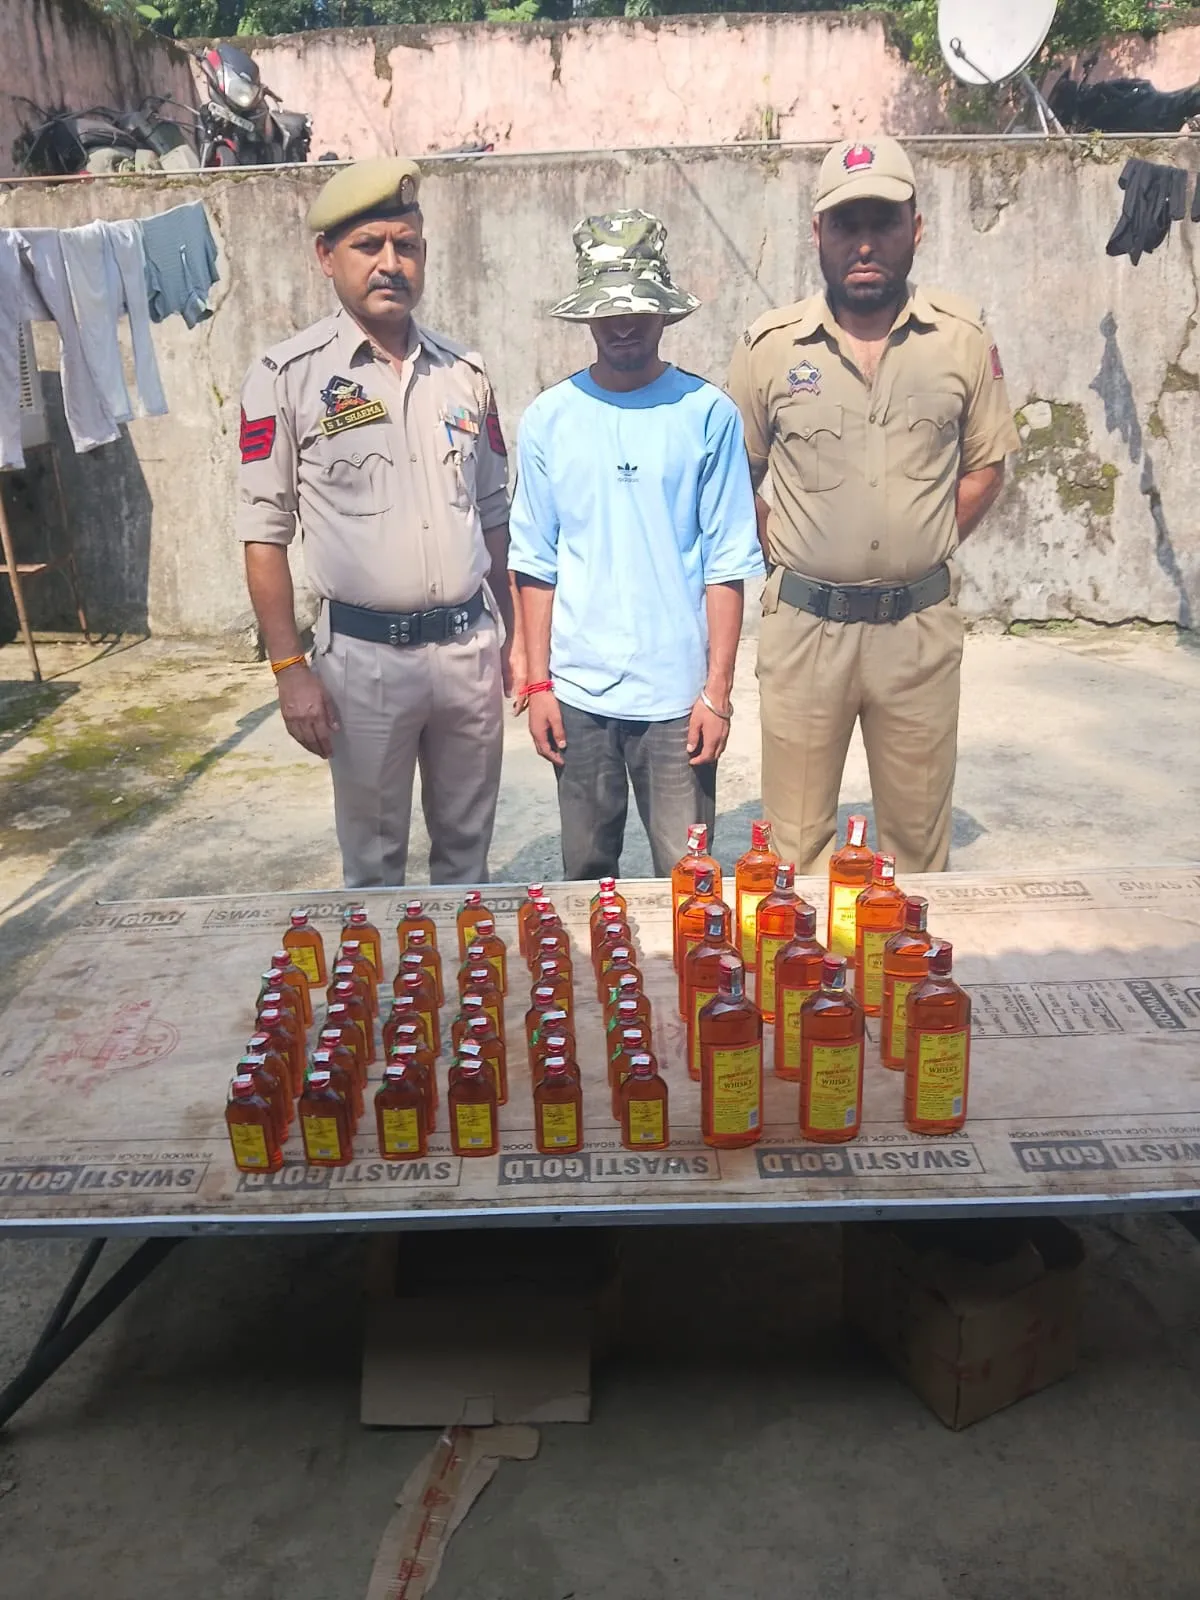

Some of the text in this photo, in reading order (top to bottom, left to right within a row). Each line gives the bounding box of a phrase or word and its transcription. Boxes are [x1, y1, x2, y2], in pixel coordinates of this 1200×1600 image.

[327, 404, 382, 430] S L SHARMA
[935, 885, 1019, 898] SWASTI
[1131, 982, 1177, 1027] PLYWOOD
[503, 1143, 534, 1151] DOOR
[1021, 1142, 1200, 1167] WASTI GOLD
[333, 1162, 451, 1183] SWASTI
[503, 1155, 709, 1179] SWASTI GOLD
[762, 1150, 971, 1173] SWASTI GOLD
[0, 1168, 197, 1192] SWASTI GOLD
